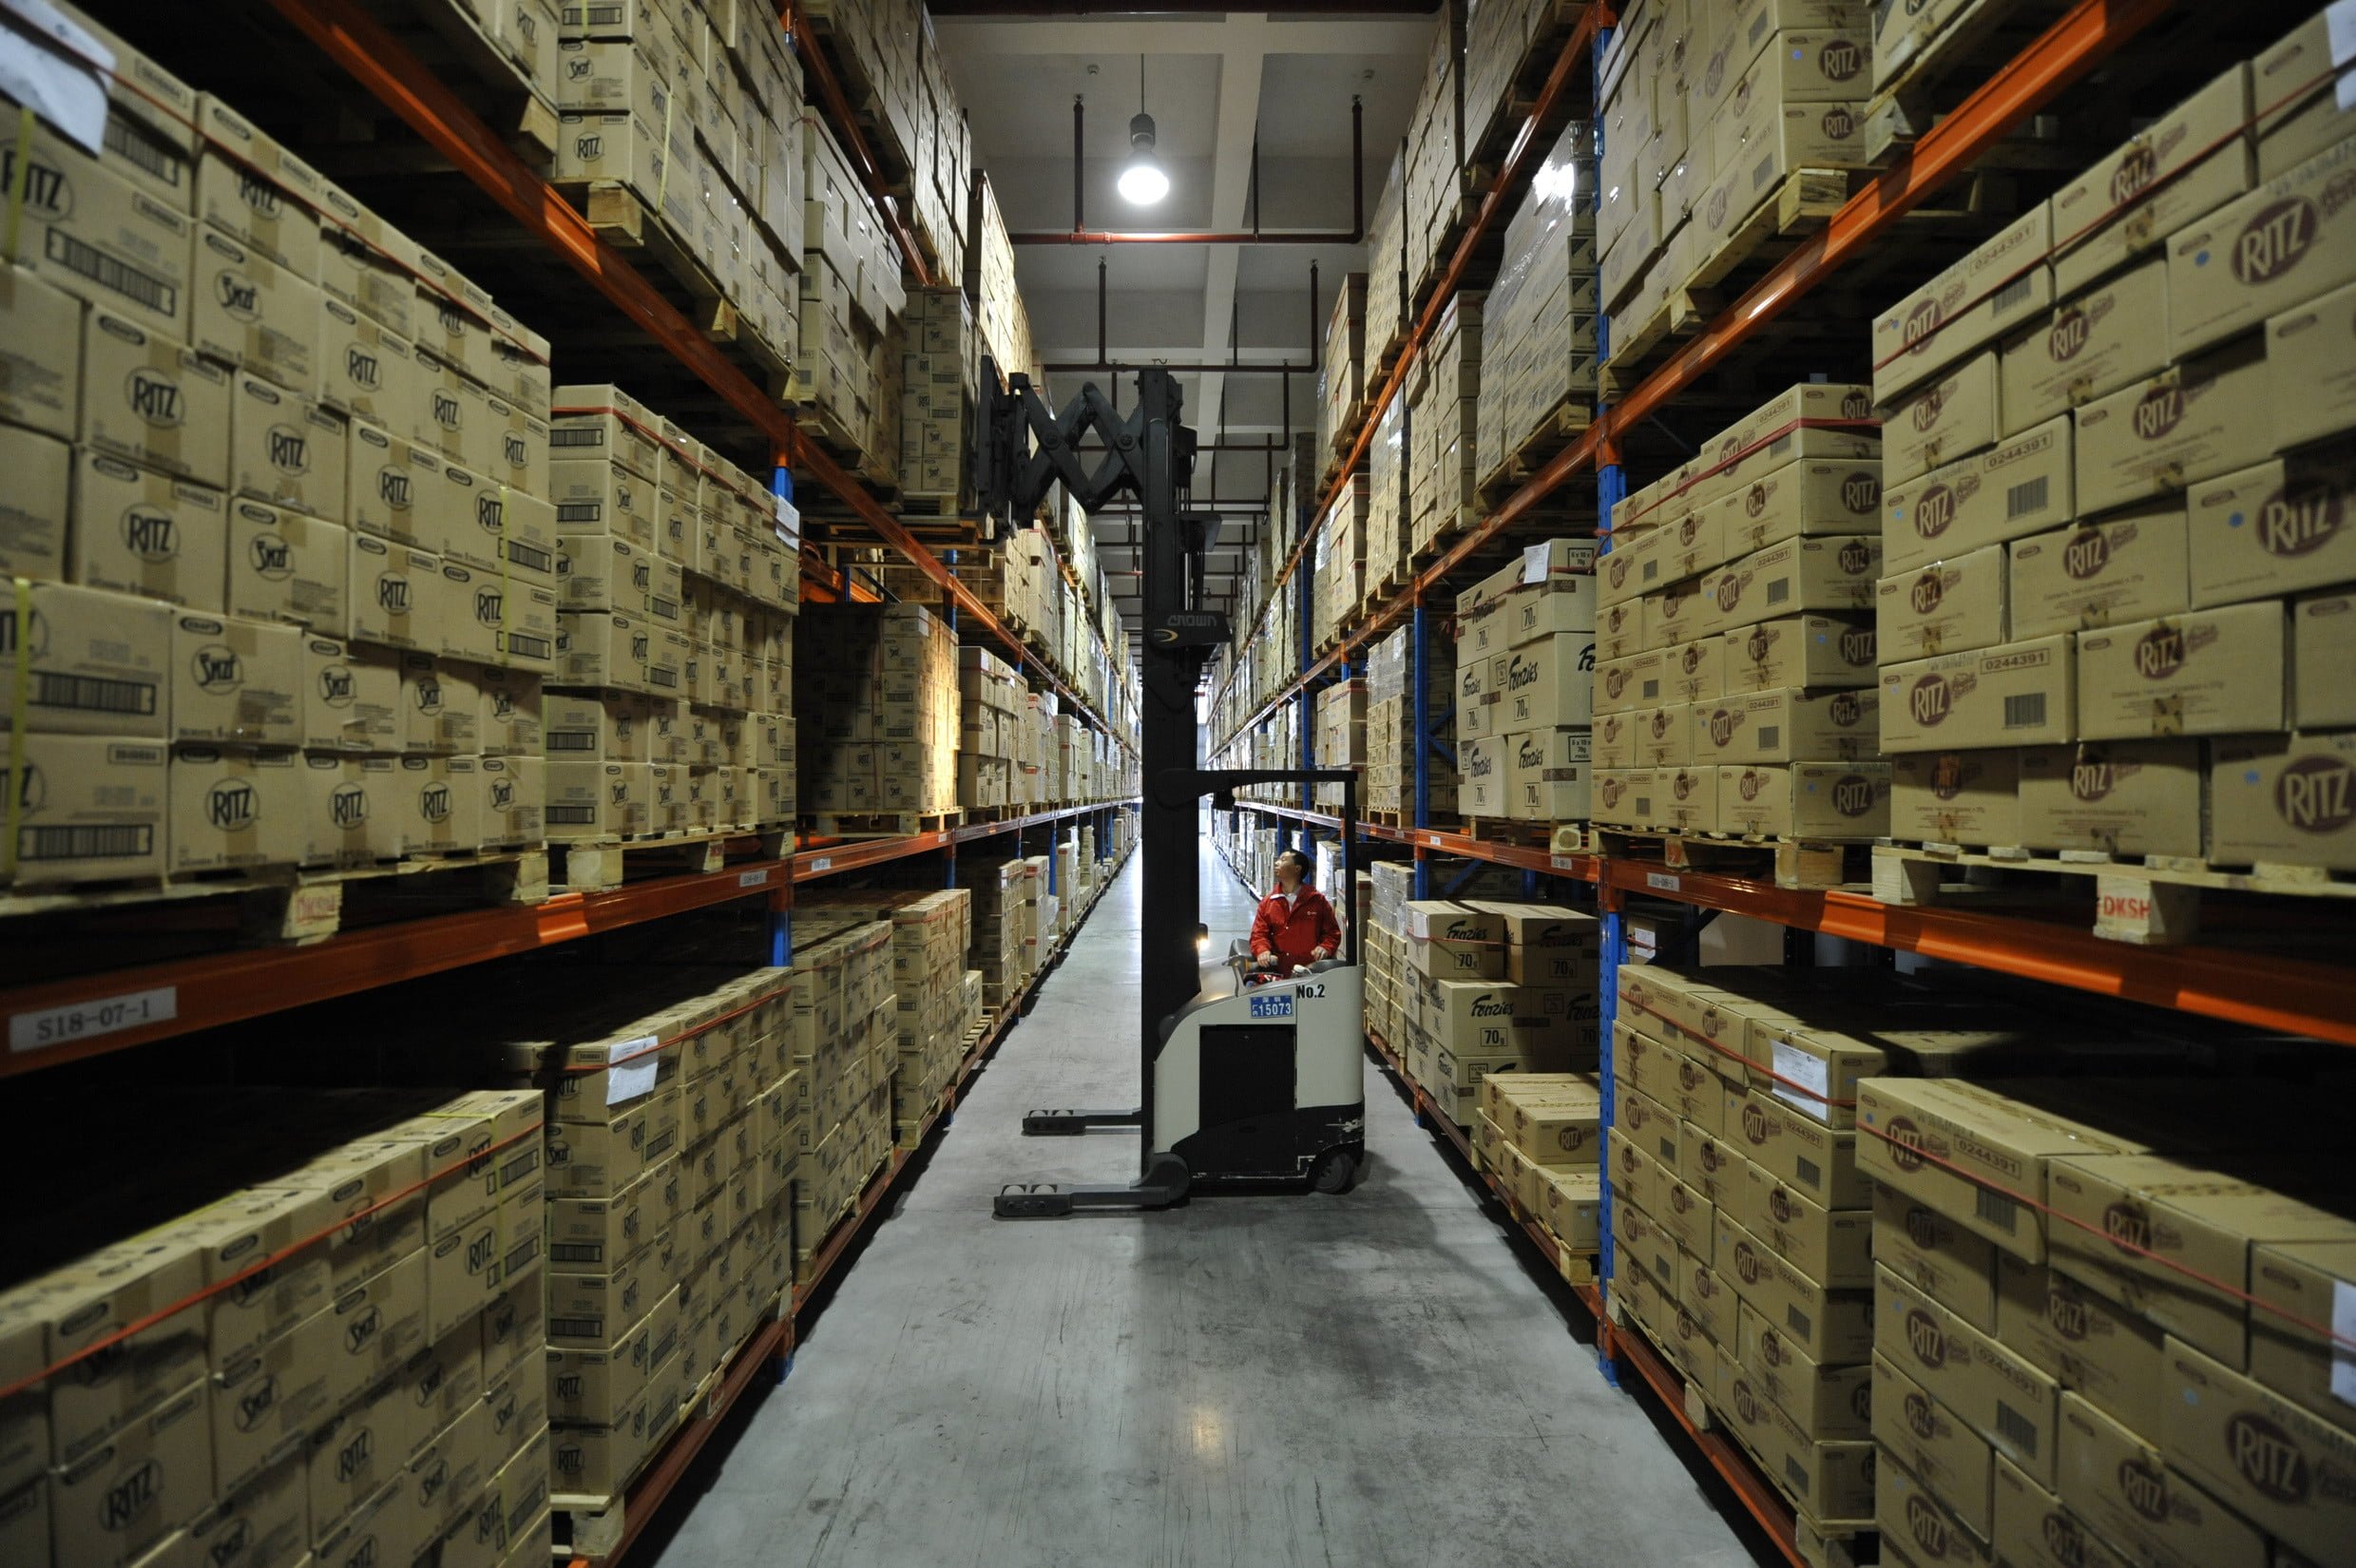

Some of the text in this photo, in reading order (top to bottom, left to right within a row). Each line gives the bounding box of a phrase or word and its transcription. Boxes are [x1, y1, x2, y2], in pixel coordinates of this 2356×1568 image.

[1825, 48, 1856, 77] RITZ
[1825, 115, 1848, 136] RITZ
[1975, 226, 2032, 270] 0244391
[2243, 202, 2304, 282] RITZ
[2052, 315, 2086, 358] RITZ
[1845, 398, 1868, 419] RITZ
[2136, 387, 2179, 430] RITZ
[1989, 437, 2048, 468] 0244391
[1846, 479, 1876, 510] RITZ
[1920, 492, 1949, 535] RITZ
[2266, 483, 2334, 551] RITZ
[1757, 548, 1790, 567] 0244391
[2069, 538, 2102, 575] RITZ
[1719, 580, 1738, 609] RITZ
[1841, 630, 1875, 663] RITZ
[1984, 652, 2044, 671] 0244391
[2141, 635, 2178, 675] RITZ
[1915, 682, 1945, 721] RITZ
[1713, 715, 1730, 743] RITZ
[2073, 760, 2111, 796] RITZ
[1837, 783, 1868, 813] RITZ
[2285, 766, 2354, 826] RITZ
[2104, 895, 2152, 920] DKSH
[1296, 985, 1325, 998] No.2
[1471, 994, 1513, 1017] Fonzies
[37, 1001, 149, 1042] S18-07-1
[1259, 1004, 1291, 1015] 15073
[1744, 1108, 1765, 1141] RITZ
[1786, 1119, 1821, 1147] 0244391
[1959, 1139, 2018, 1176] 0244391
[1738, 1251, 1758, 1282] RITZ
[1909, 1316, 1944, 1368] RITZ
[2231, 1420, 2302, 1498] RITZ
[2124, 1468, 2164, 1518] RITZ
[1909, 1501, 1944, 1556] RITZ
